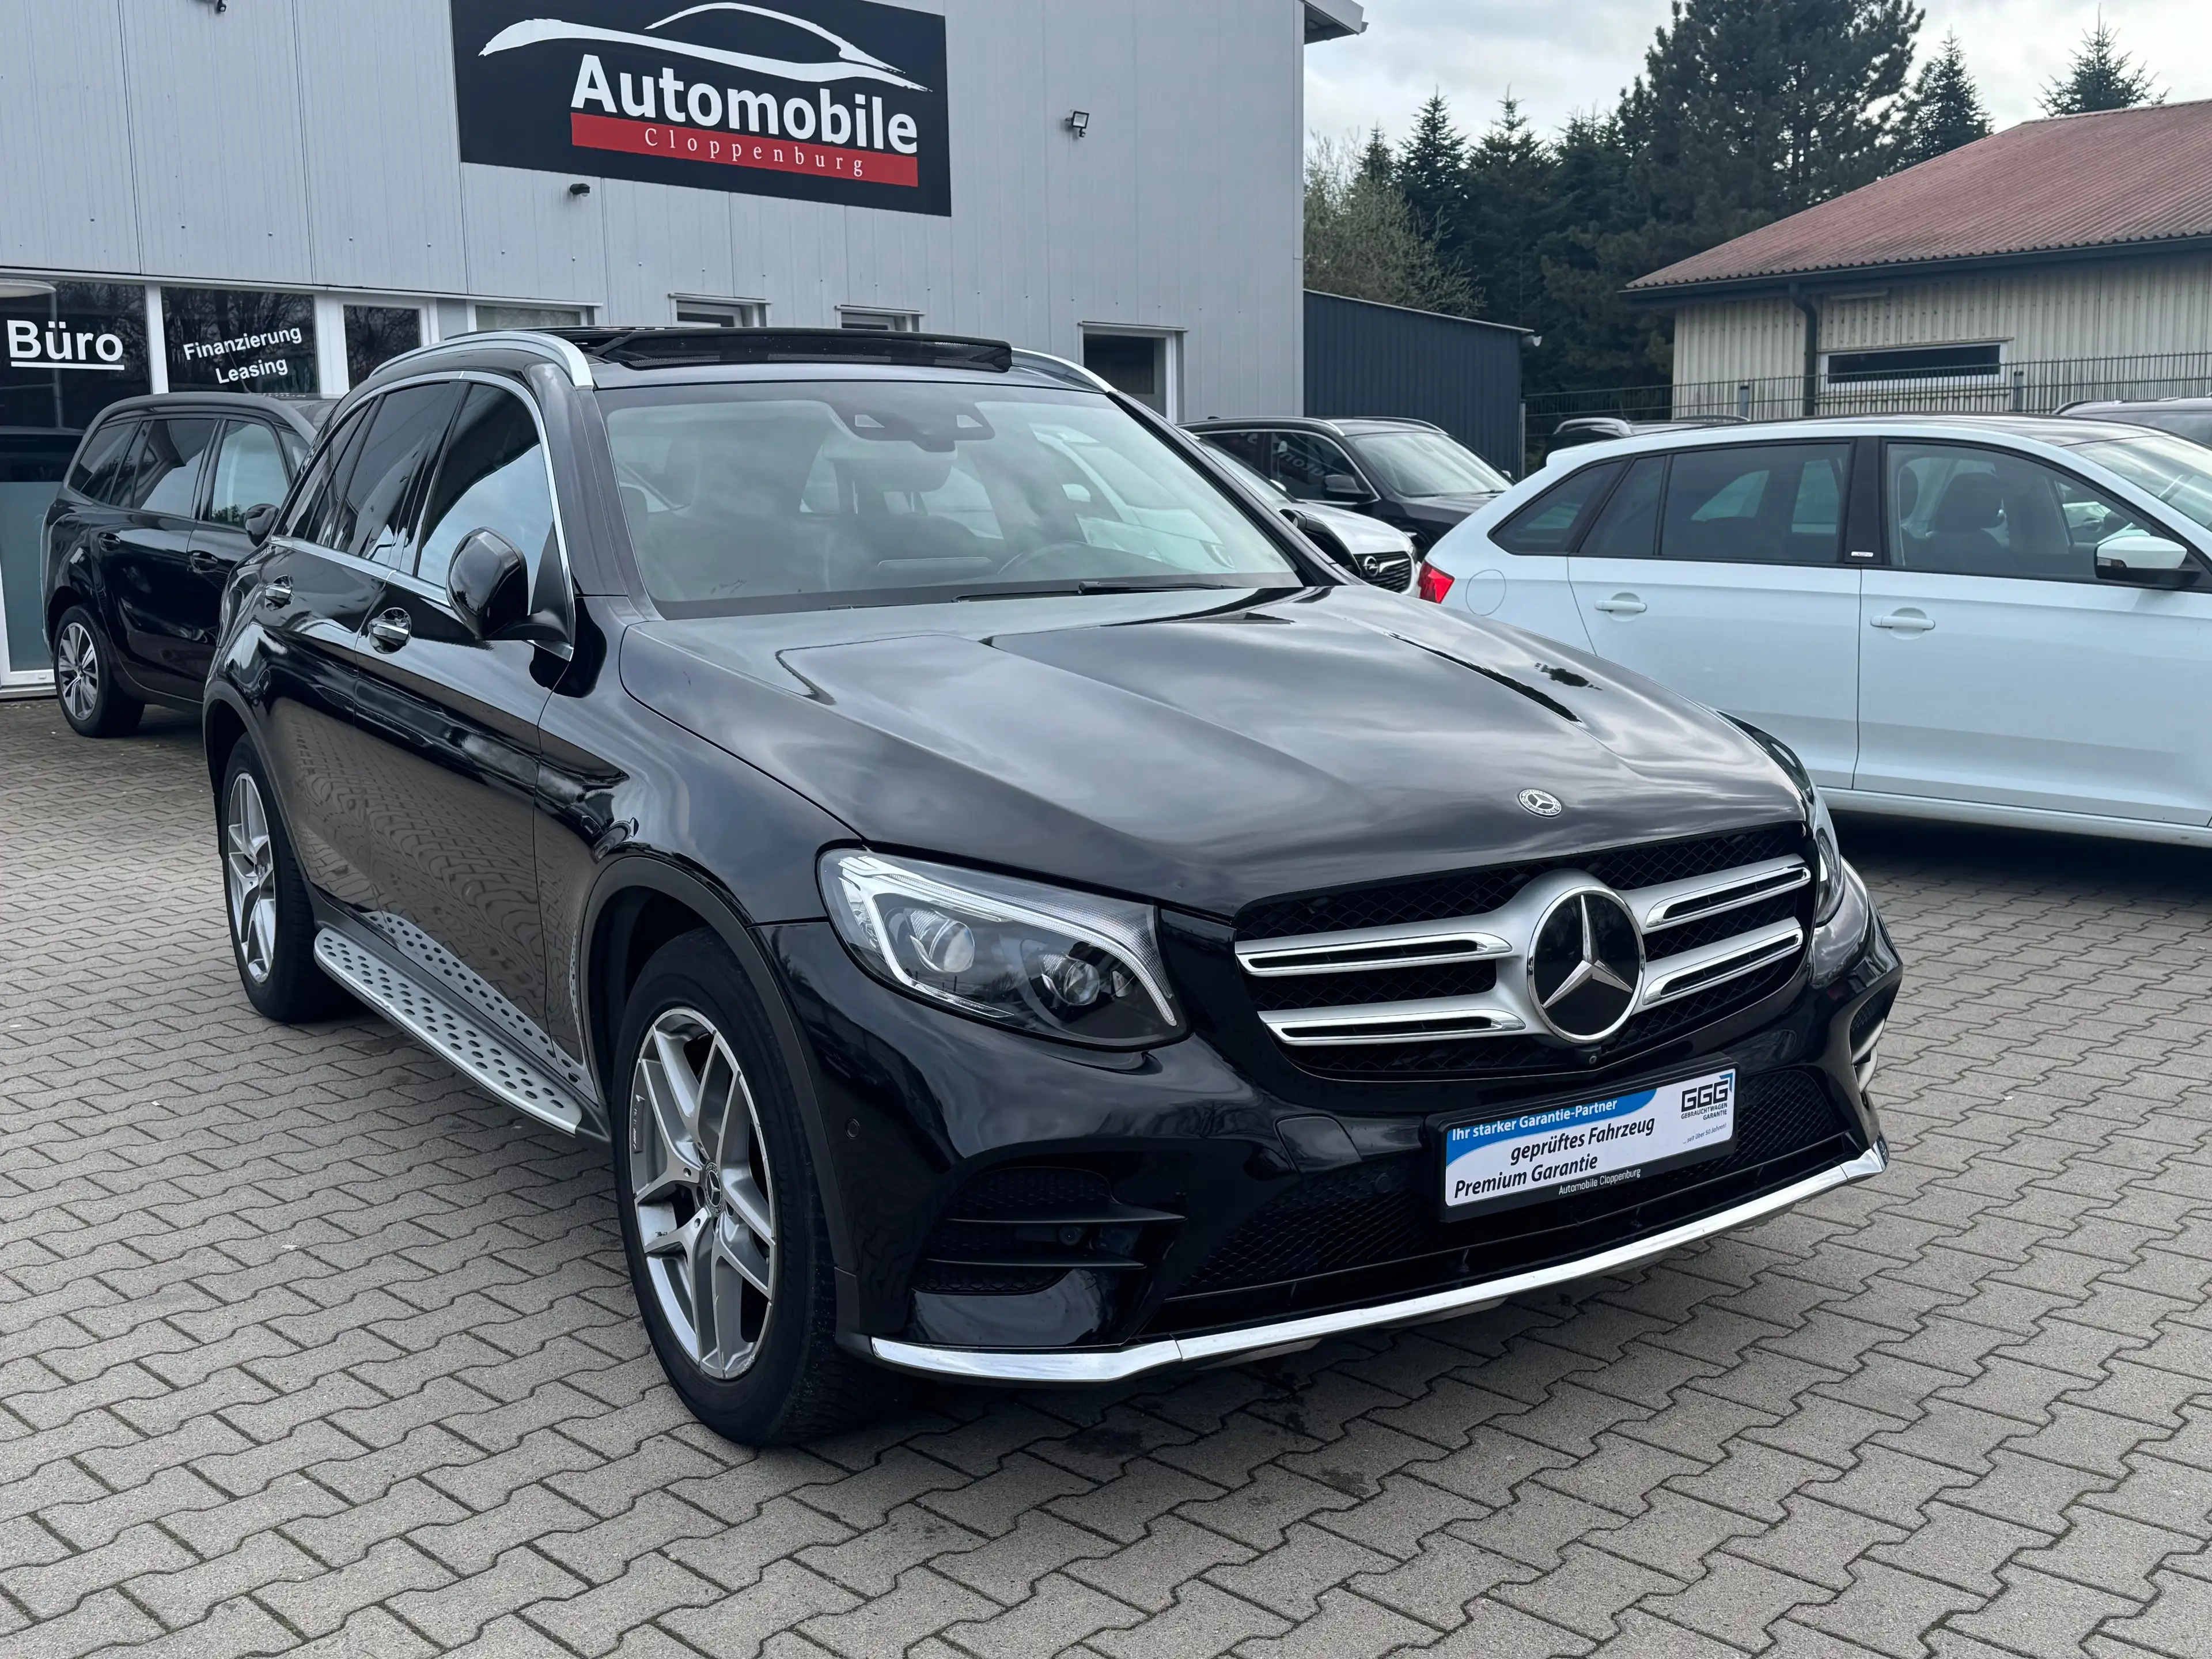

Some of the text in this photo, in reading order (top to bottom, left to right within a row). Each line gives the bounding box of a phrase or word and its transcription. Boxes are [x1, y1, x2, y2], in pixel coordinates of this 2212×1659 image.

[571, 54, 918, 154] Automobile
[645, 128, 863, 177] Cloppenburg
[7, 320, 123, 362] Büro
[183, 326, 301, 361] Finanzierung
[215, 358, 288, 384] Leasing
[1681, 1079, 1729, 1113] GGG
[1681, 1102, 1728, 1119] GEBRAUCHTWAGEN
[1703, 1109, 1728, 1120] GARANTIE
[1452, 1099, 1618, 1141] Ihr starker Garantie-Partner
[1510, 1118, 1656, 1166] geprüftes Fahrzeug
[1454, 1153, 1598, 1198] Premium Garantie
[1559, 1168, 1641, 1195] Automobile Cloppenburg
